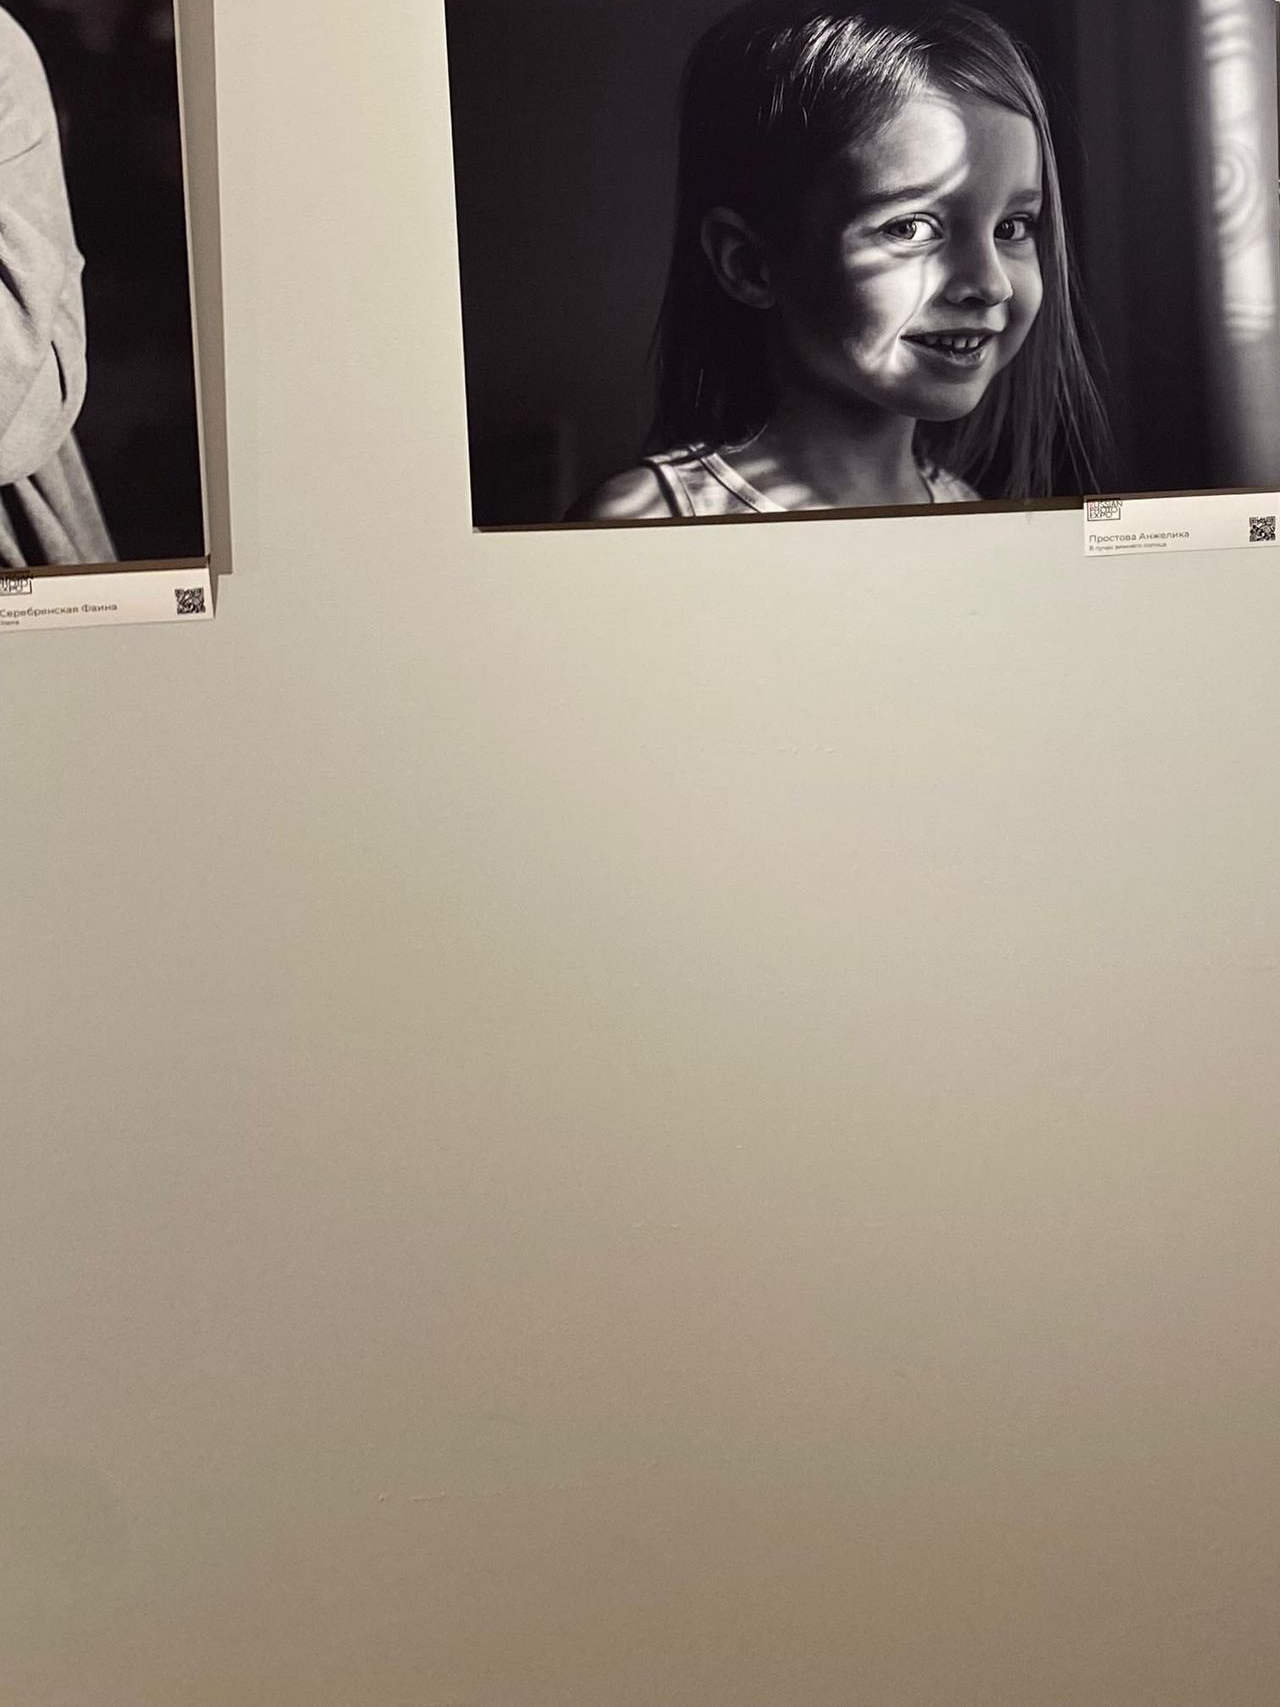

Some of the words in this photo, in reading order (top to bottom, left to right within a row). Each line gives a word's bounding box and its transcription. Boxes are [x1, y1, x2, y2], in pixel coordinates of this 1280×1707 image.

[1089, 534, 1137, 543] Простова
[1139, 531, 1190, 540] Анжелика
[81, 603, 118, 613] Фаина
